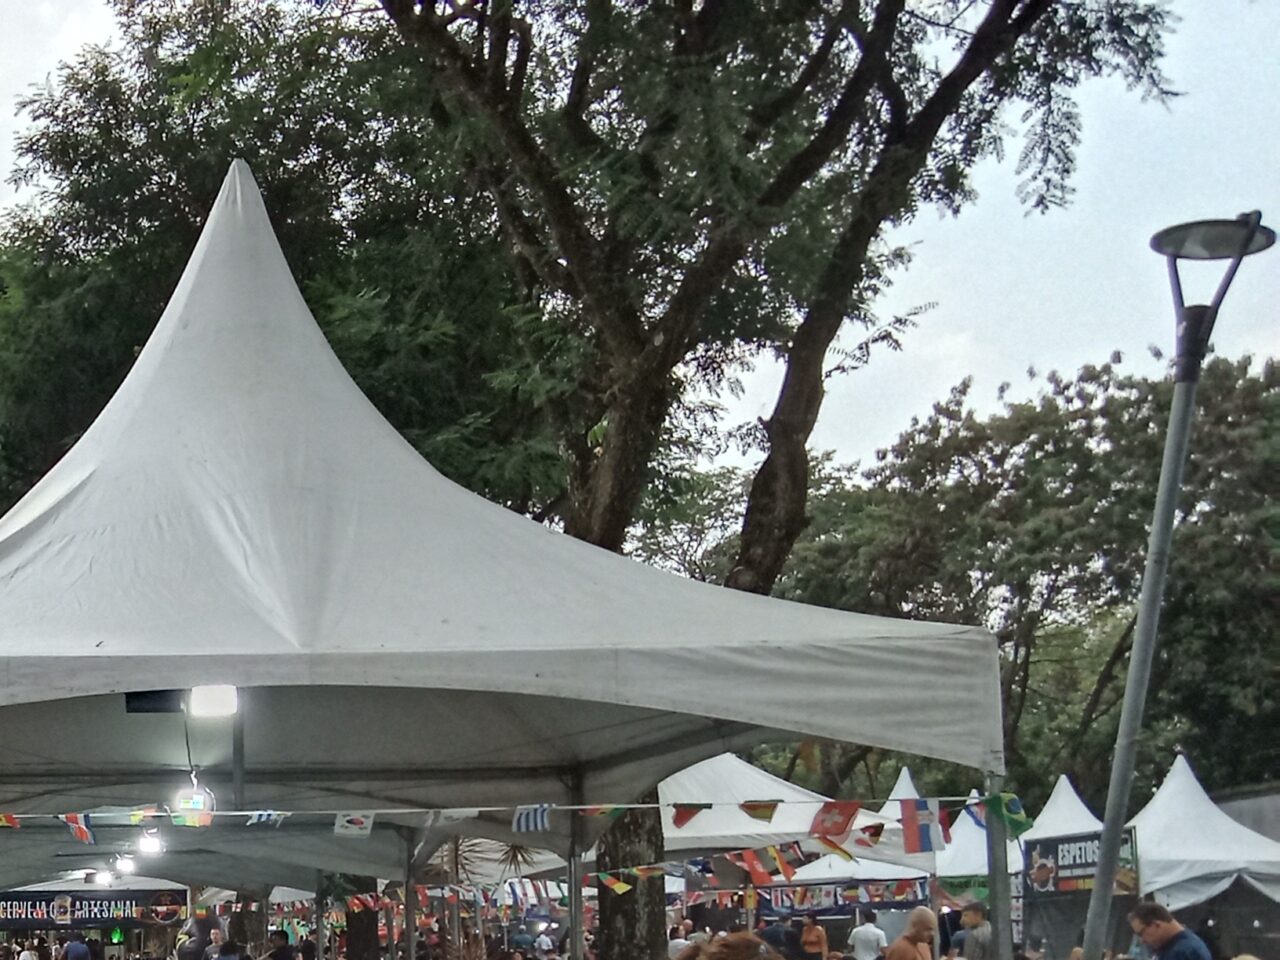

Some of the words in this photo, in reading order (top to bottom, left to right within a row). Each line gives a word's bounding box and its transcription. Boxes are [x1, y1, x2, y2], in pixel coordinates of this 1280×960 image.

[1058, 840, 1100, 866] ESPETOS
[0, 900, 48, 919] CERVEJA
[74, 900, 138, 919] ARTESANAL
